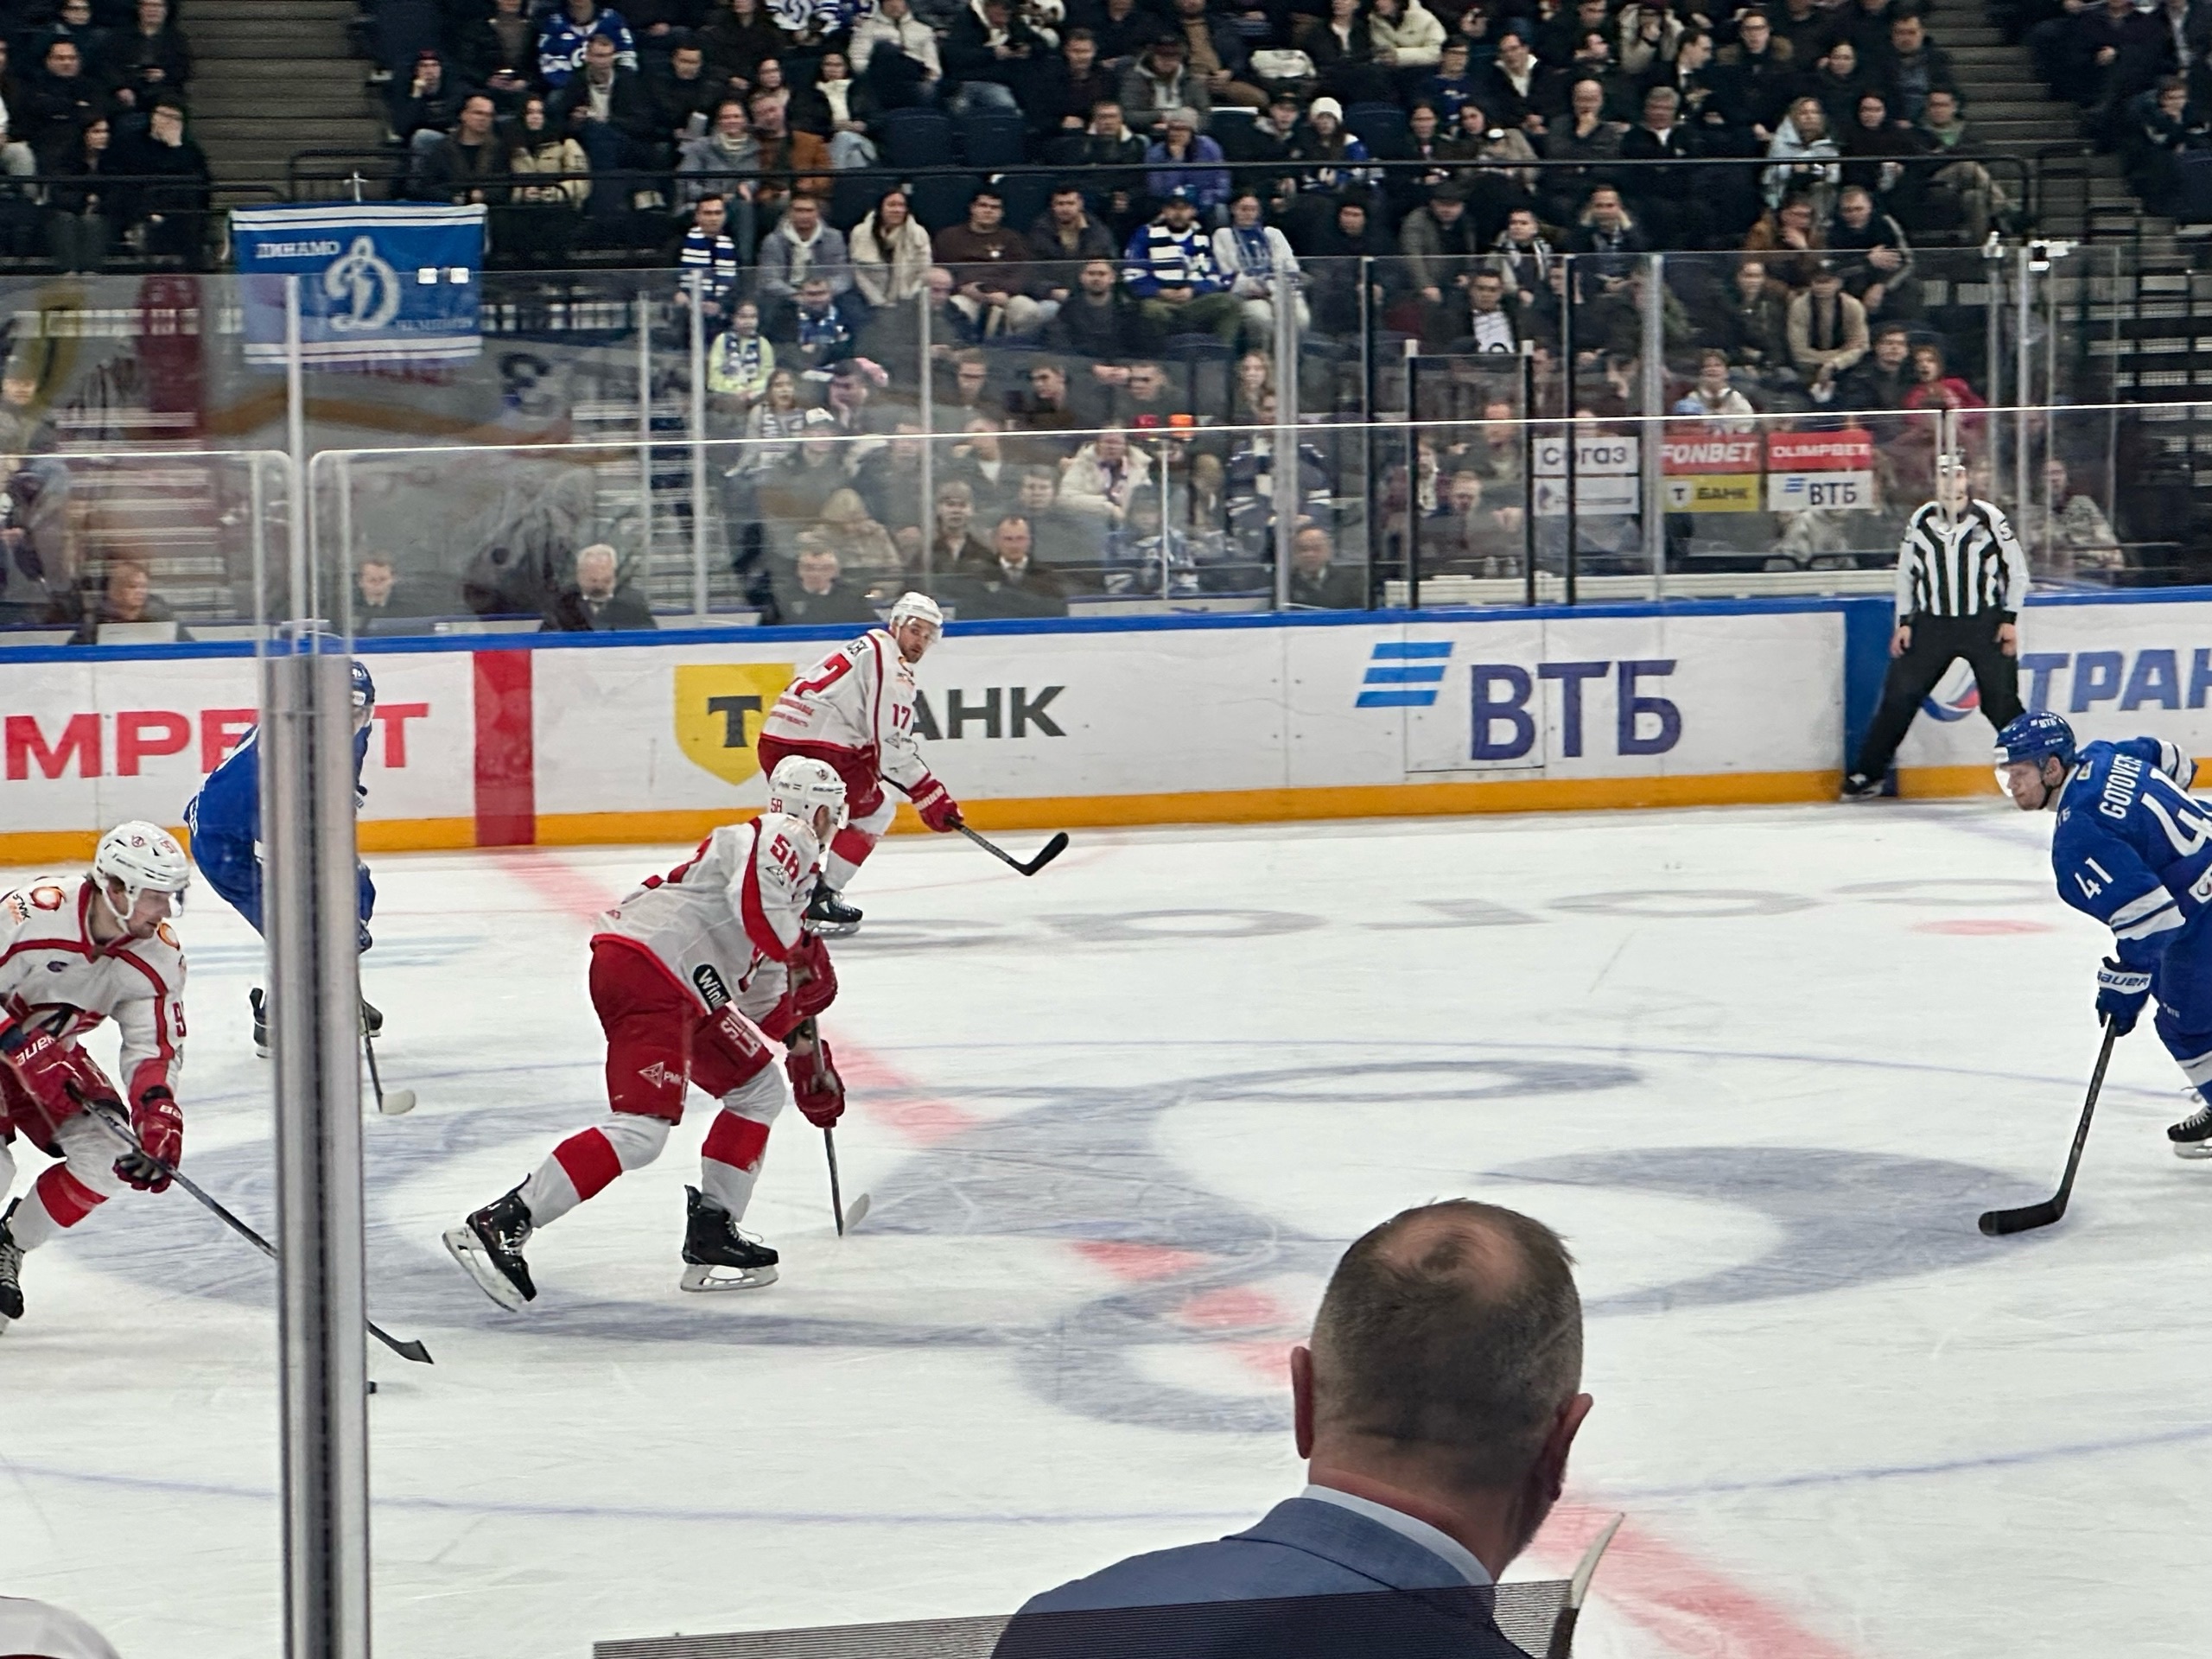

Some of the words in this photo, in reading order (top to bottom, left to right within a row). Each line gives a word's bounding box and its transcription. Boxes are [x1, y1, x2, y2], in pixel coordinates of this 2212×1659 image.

[1543, 446, 1626, 466] сгаз
[1660, 442, 1757, 465] FONBET
[1809, 482, 1857, 505] ВТБ
[893, 703, 912, 730] 17
[910, 685, 1067, 741] АНК
[1471, 659, 1681, 761] ВТБ
[770, 833, 800, 883] 58
[2074, 857, 2114, 899] 41
